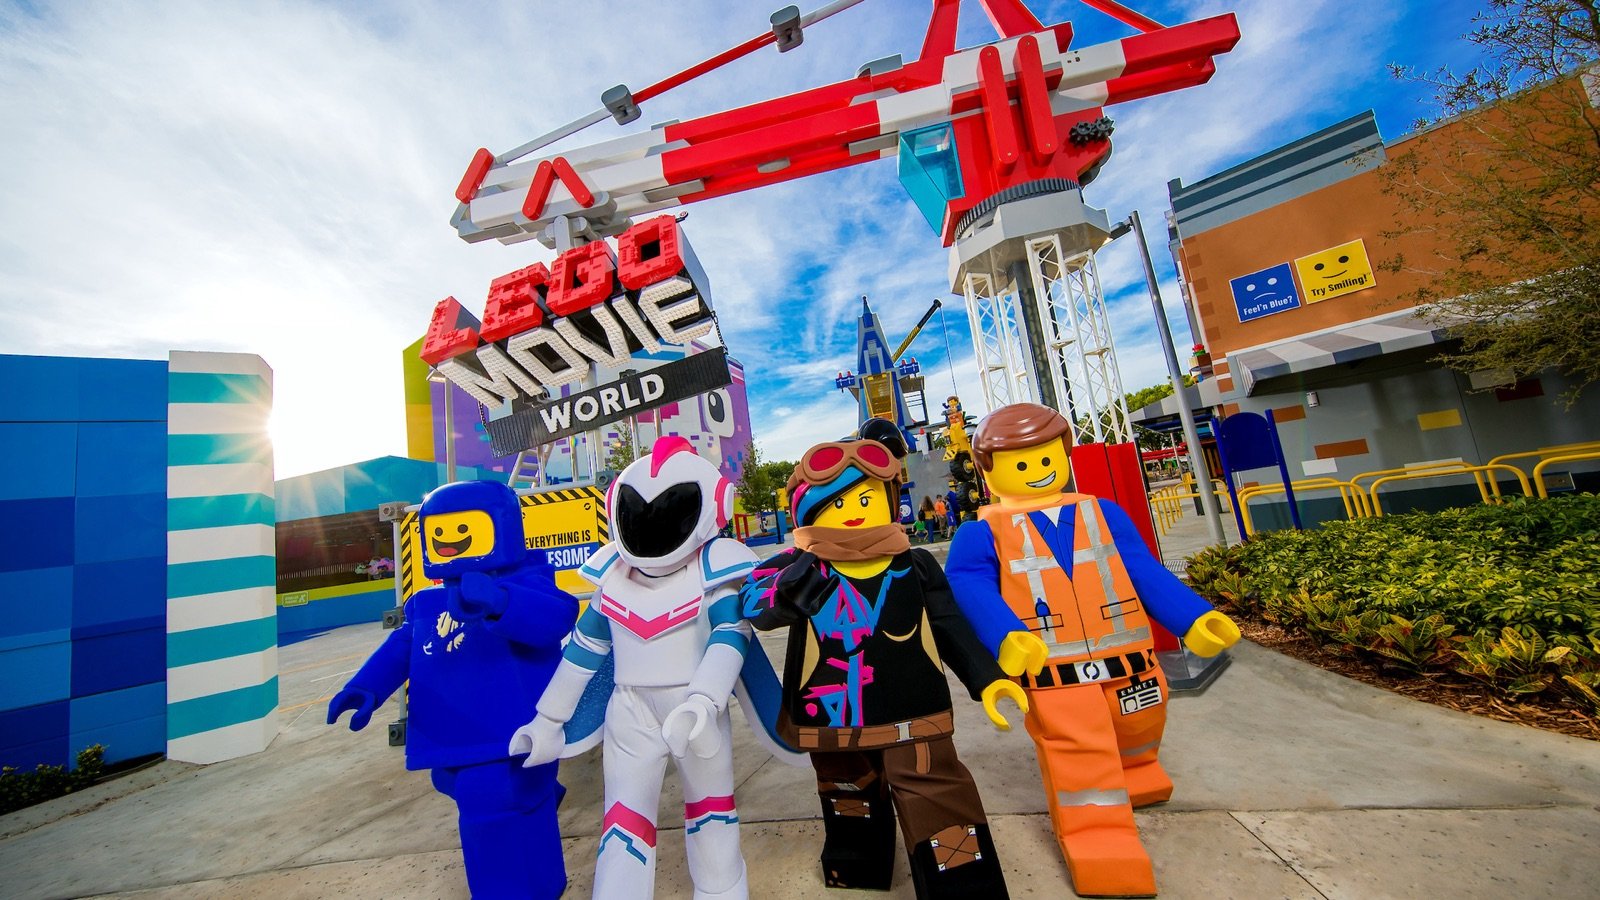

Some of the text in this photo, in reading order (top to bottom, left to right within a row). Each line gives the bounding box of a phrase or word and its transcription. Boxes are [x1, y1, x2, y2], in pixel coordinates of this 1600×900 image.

[420, 214, 684, 365] LEGO
[1311, 275, 1367, 297] Try Smiling!
[1243, 295, 1293, 316] Feel'n Blue?
[437, 275, 713, 410] MOVIE
[540, 374, 665, 433] WORLD
[582, 530, 591, 541] IS
[547, 546, 591, 567] ESOME
[1121, 680, 1153, 696] EMMET
